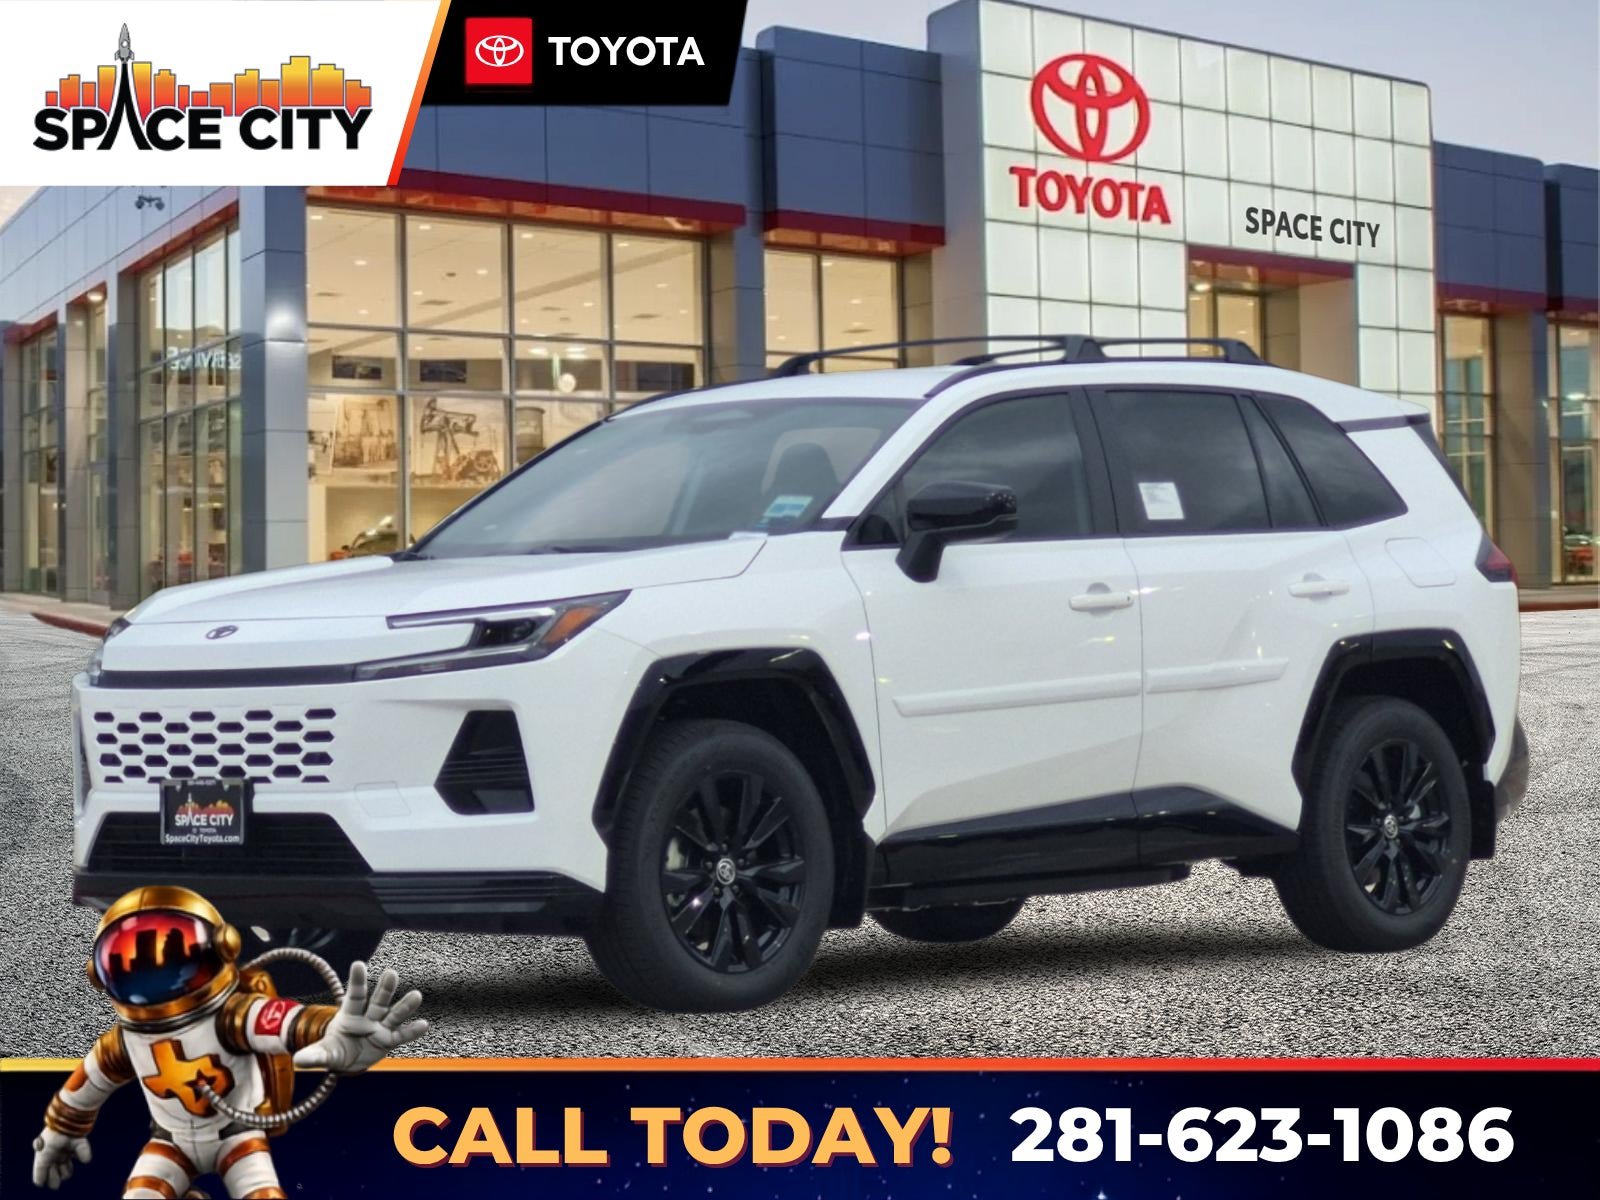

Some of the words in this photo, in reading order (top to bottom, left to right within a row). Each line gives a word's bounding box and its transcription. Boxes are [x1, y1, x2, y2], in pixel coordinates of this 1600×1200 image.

[1009, 166, 1171, 225] TOYOTA
[1245, 206, 1323, 242] SPACE
[1329, 218, 1380, 249] CITY
[174, 814, 208, 827] SPACE
[209, 814, 234, 827] CITY
[165, 833, 240, 845] SpaceCityToyota.com
